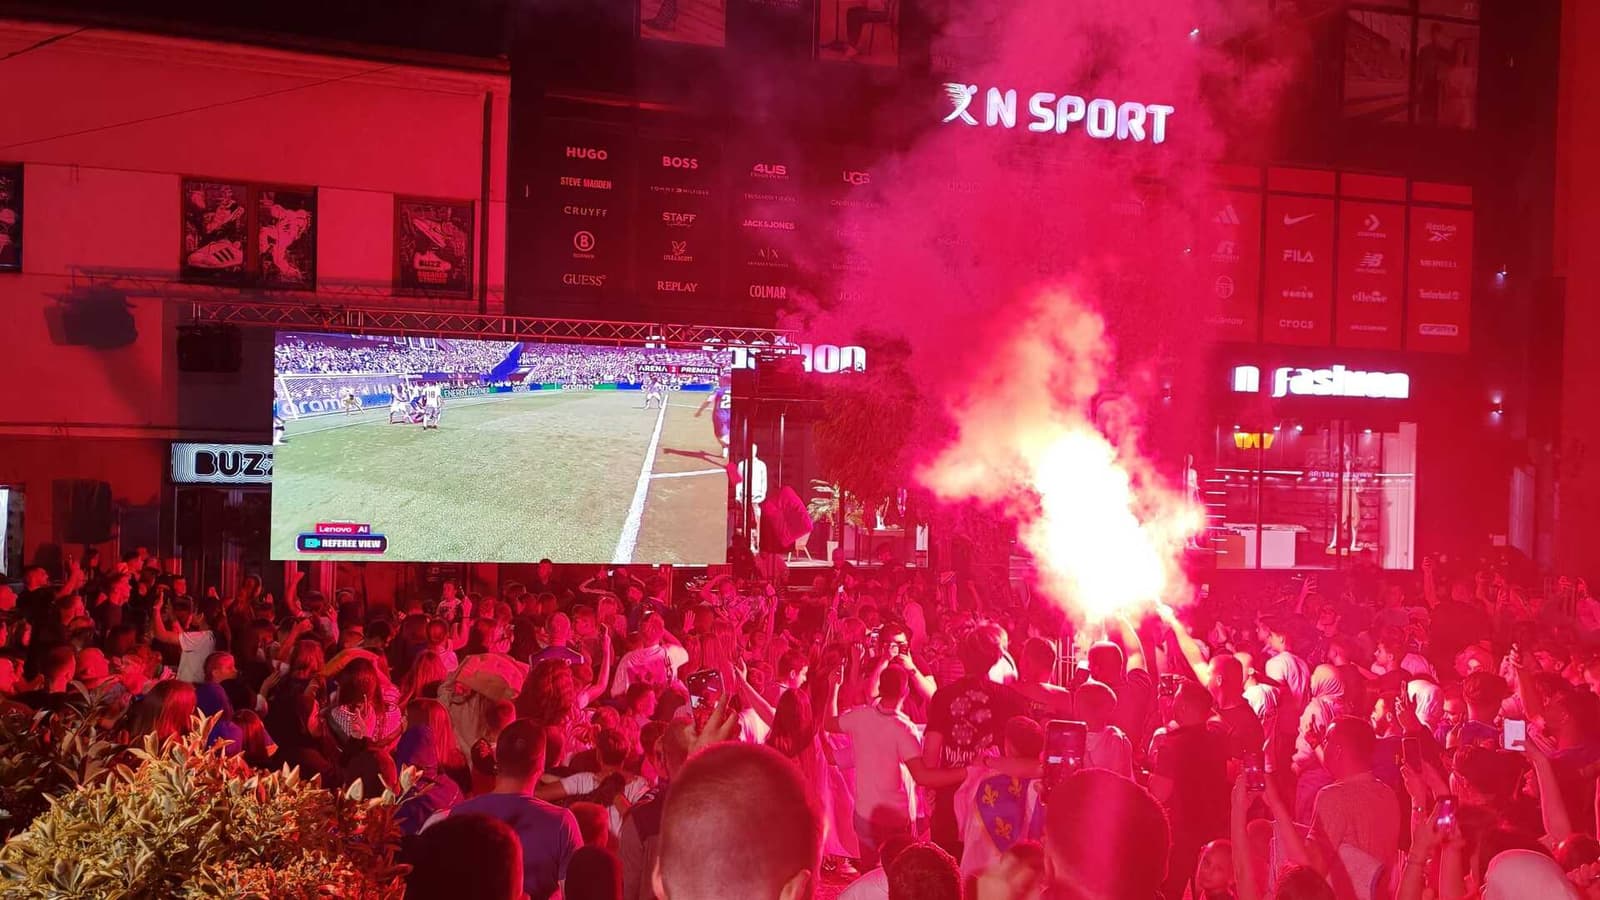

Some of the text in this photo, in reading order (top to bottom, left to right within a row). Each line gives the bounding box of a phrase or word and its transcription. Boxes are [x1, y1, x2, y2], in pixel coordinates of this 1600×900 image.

[985, 87, 1175, 145] N SPORT
[566, 146, 608, 160] HUGO
[662, 156, 699, 169] BOSS
[753, 163, 787, 174] 4US
[560, 176, 582, 187] STEVE
[842, 170, 872, 185] UGG
[563, 205, 609, 217] CRUYFF
[662, 212, 697, 223] STAFF
[1283, 250, 1314, 263] FILA
[657, 280, 698, 293] REPLAY
[749, 284, 787, 300] COLMAR
[1280, 319, 1314, 329] crocs
[638, 365, 668, 373] ARENA
[681, 366, 719, 374] PREMIUM
[322, 539, 381, 548] REFEREE VIEW
